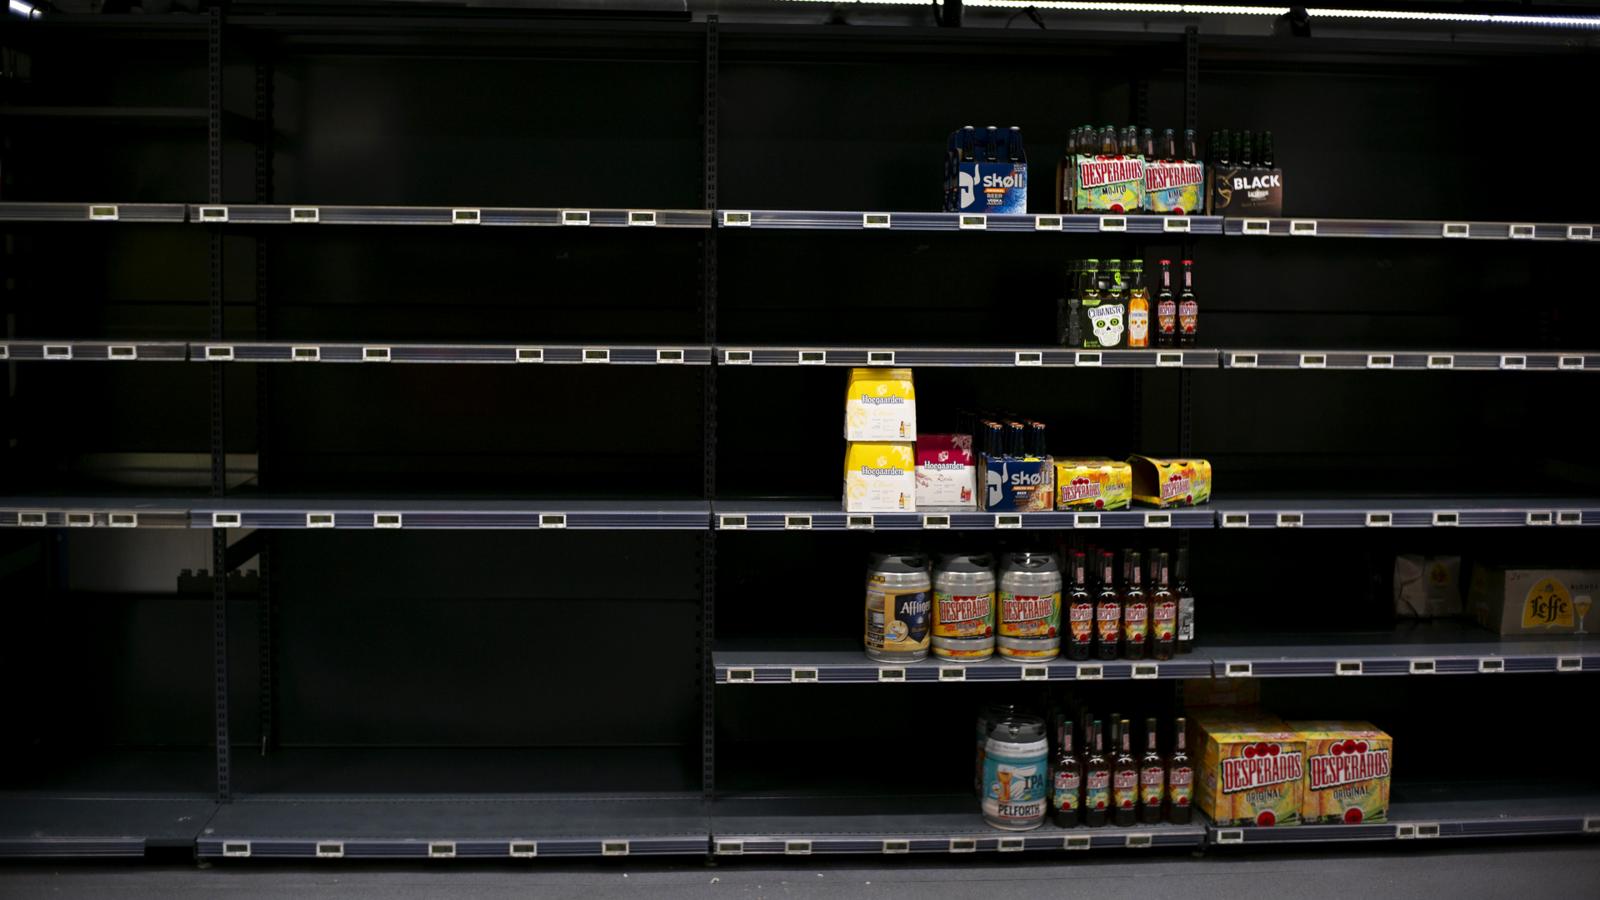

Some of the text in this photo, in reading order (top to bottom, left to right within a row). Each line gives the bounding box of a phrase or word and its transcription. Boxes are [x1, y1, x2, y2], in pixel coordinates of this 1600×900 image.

[983, 173, 1023, 188] skøll
[1082, 161, 1143, 186] DESPERADOS
[1145, 165, 1203, 190] DESPERADOS
[1233, 174, 1281, 190] BLACK
[861, 394, 904, 406] Hoegaarden
[861, 466, 904, 477] Hoegaarden
[924, 460, 965, 471] Hoegaarden
[1011, 470, 1050, 486] skøll
[940, 598, 990, 622] DESPERADOS
[1003, 598, 1053, 622] DESPERADOS
[1530, 593, 1569, 622] Leffe
[1224, 754, 1302, 790] DESPERADOS
[1310, 752, 1389, 787] DESPERADOS
[1024, 774, 1044, 790] IPA
[1333, 787, 1369, 800] ORIGINAL
[998, 803, 1041, 816] PELFORTH
